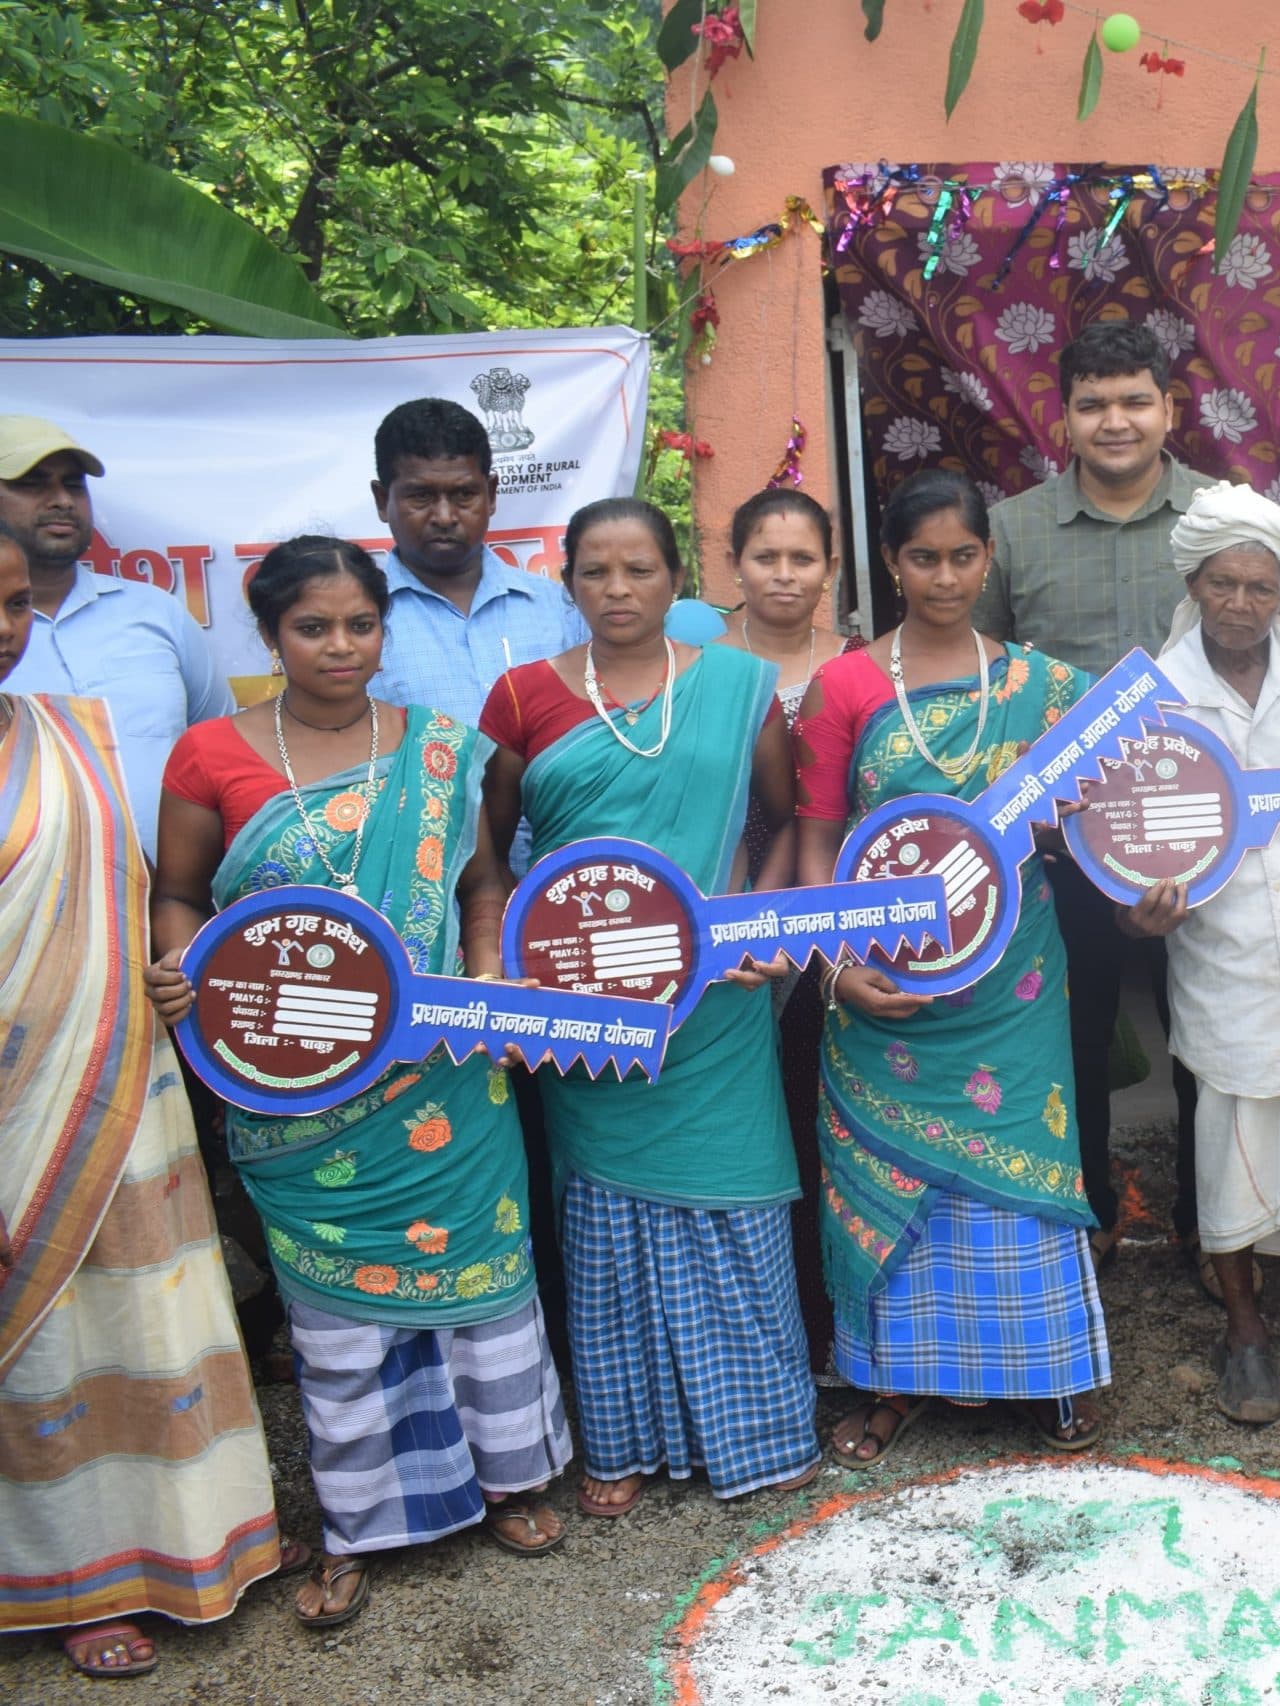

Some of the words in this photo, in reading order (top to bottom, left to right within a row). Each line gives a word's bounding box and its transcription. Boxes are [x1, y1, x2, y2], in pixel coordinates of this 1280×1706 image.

[500, 473, 551, 485] OPMENT
[528, 463, 543, 473] OF
[546, 460, 580, 471] RURAL
[527, 485, 537, 493] OF
[989, 774, 1046, 836] प्रधानमंत्री
[1038, 740, 1085, 785] जनमन
[1079, 707, 1121, 749] आवास
[1113, 672, 1158, 714] योजना
[1163, 736, 1201, 762] प्रवेश
[867, 833, 892, 858] गृह
[889, 818, 929, 841] प्रवेश
[1125, 843, 1152, 855] जिला
[546, 873, 576, 904] शुभ
[577, 865, 608, 886] गृह
[612, 864, 656, 892] प्रवेश
[244, 917, 281, 946] शुभ
[286, 914, 321, 936] गृह
[323, 919, 368, 955] प्रवेश
[710, 909, 779, 947] प्रधानमंत्री
[782, 911, 835, 934] जनमन
[838, 907, 886, 931] आवास
[888, 897, 937, 924] योजना
[229, 992, 263, 1004] PMAY-G
[411, 1001, 488, 1030] प्रधानमंत्री
[490, 1012, 549, 1036] जनमन
[550, 1019, 602, 1042] आवास
[604, 1018, 656, 1048] योजना
[244, 1032, 279, 1047] जिला
